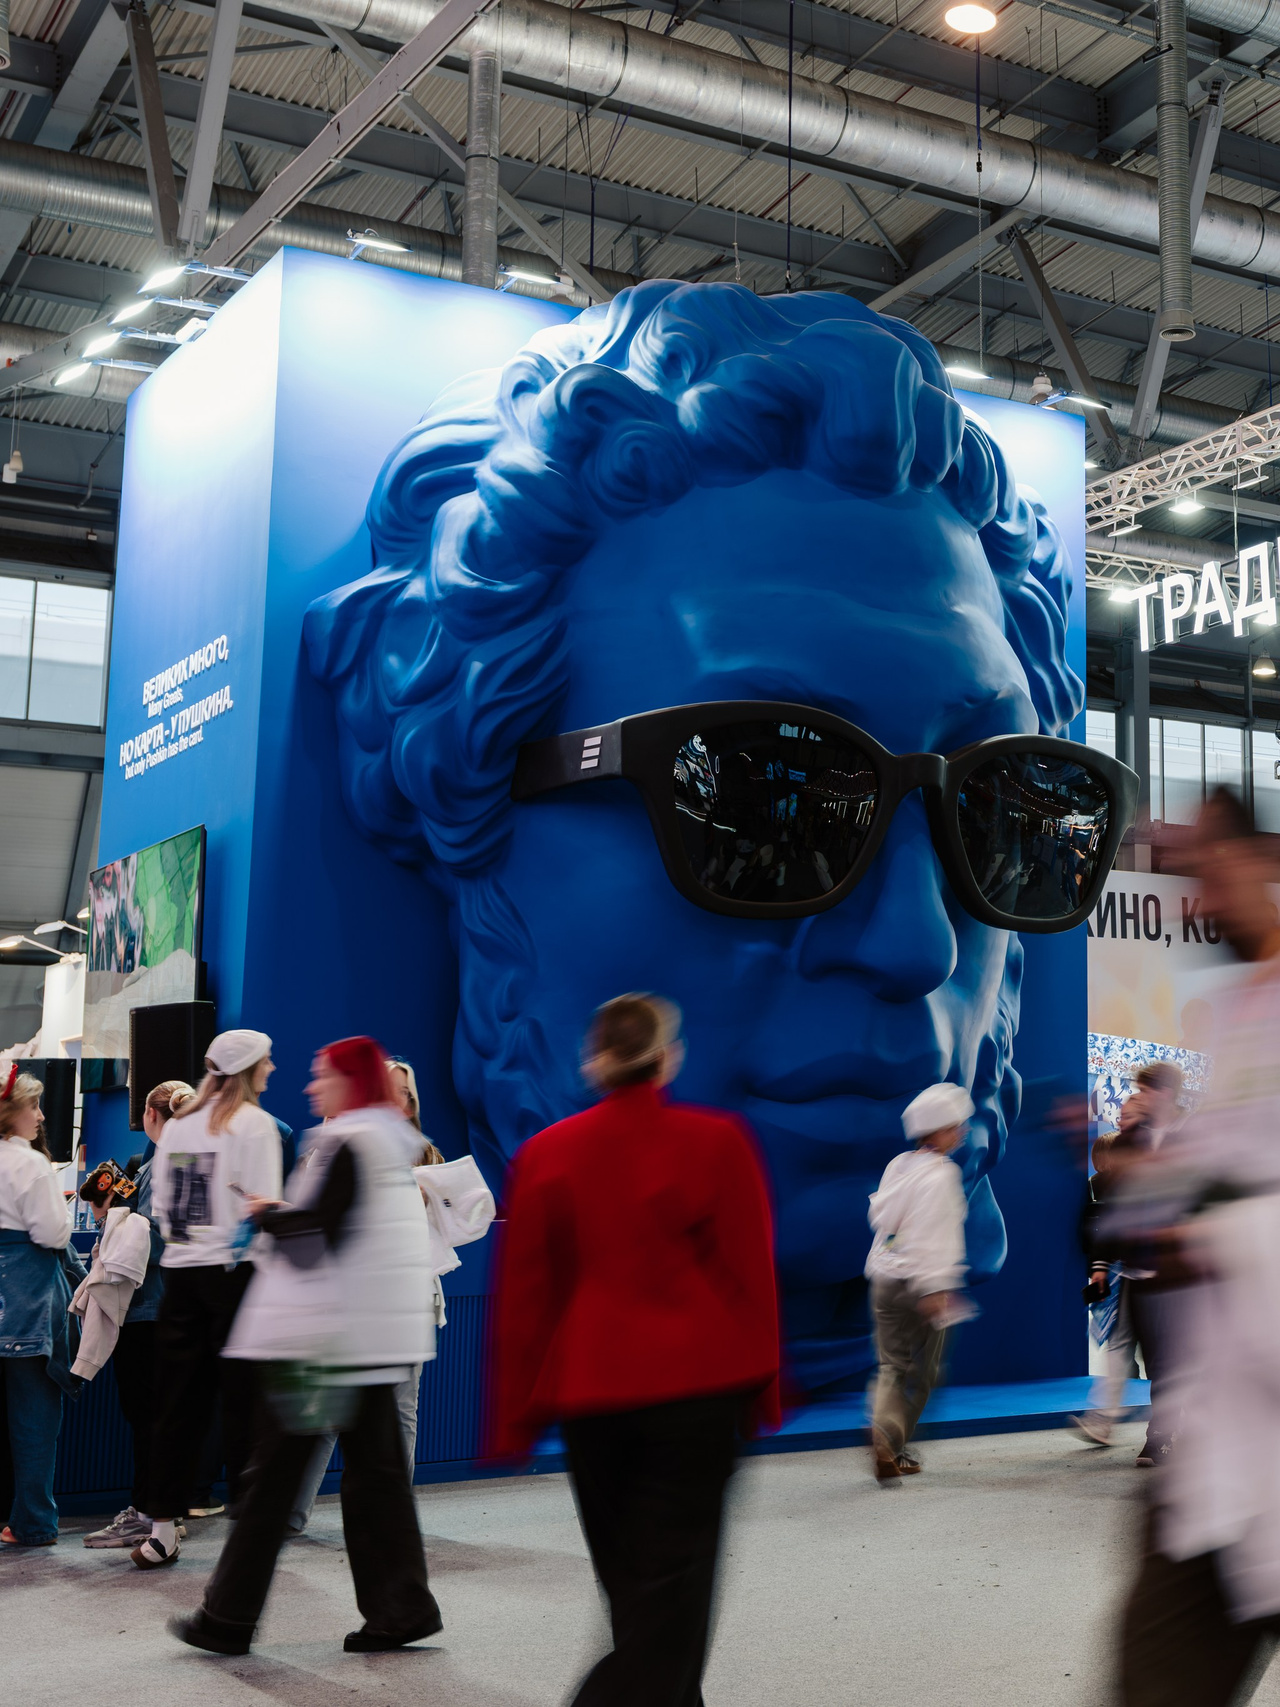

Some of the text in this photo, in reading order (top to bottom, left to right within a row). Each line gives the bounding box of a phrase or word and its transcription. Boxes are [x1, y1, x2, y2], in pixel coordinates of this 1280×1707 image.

[142, 634, 229, 706] ВЕЛИКИХ МНОГО,
[119, 740, 134, 767] НО
[134, 722, 164, 760] КАРТА
[170, 713, 179, 740] У
[178, 685, 234, 736] ПУШКИНА.
